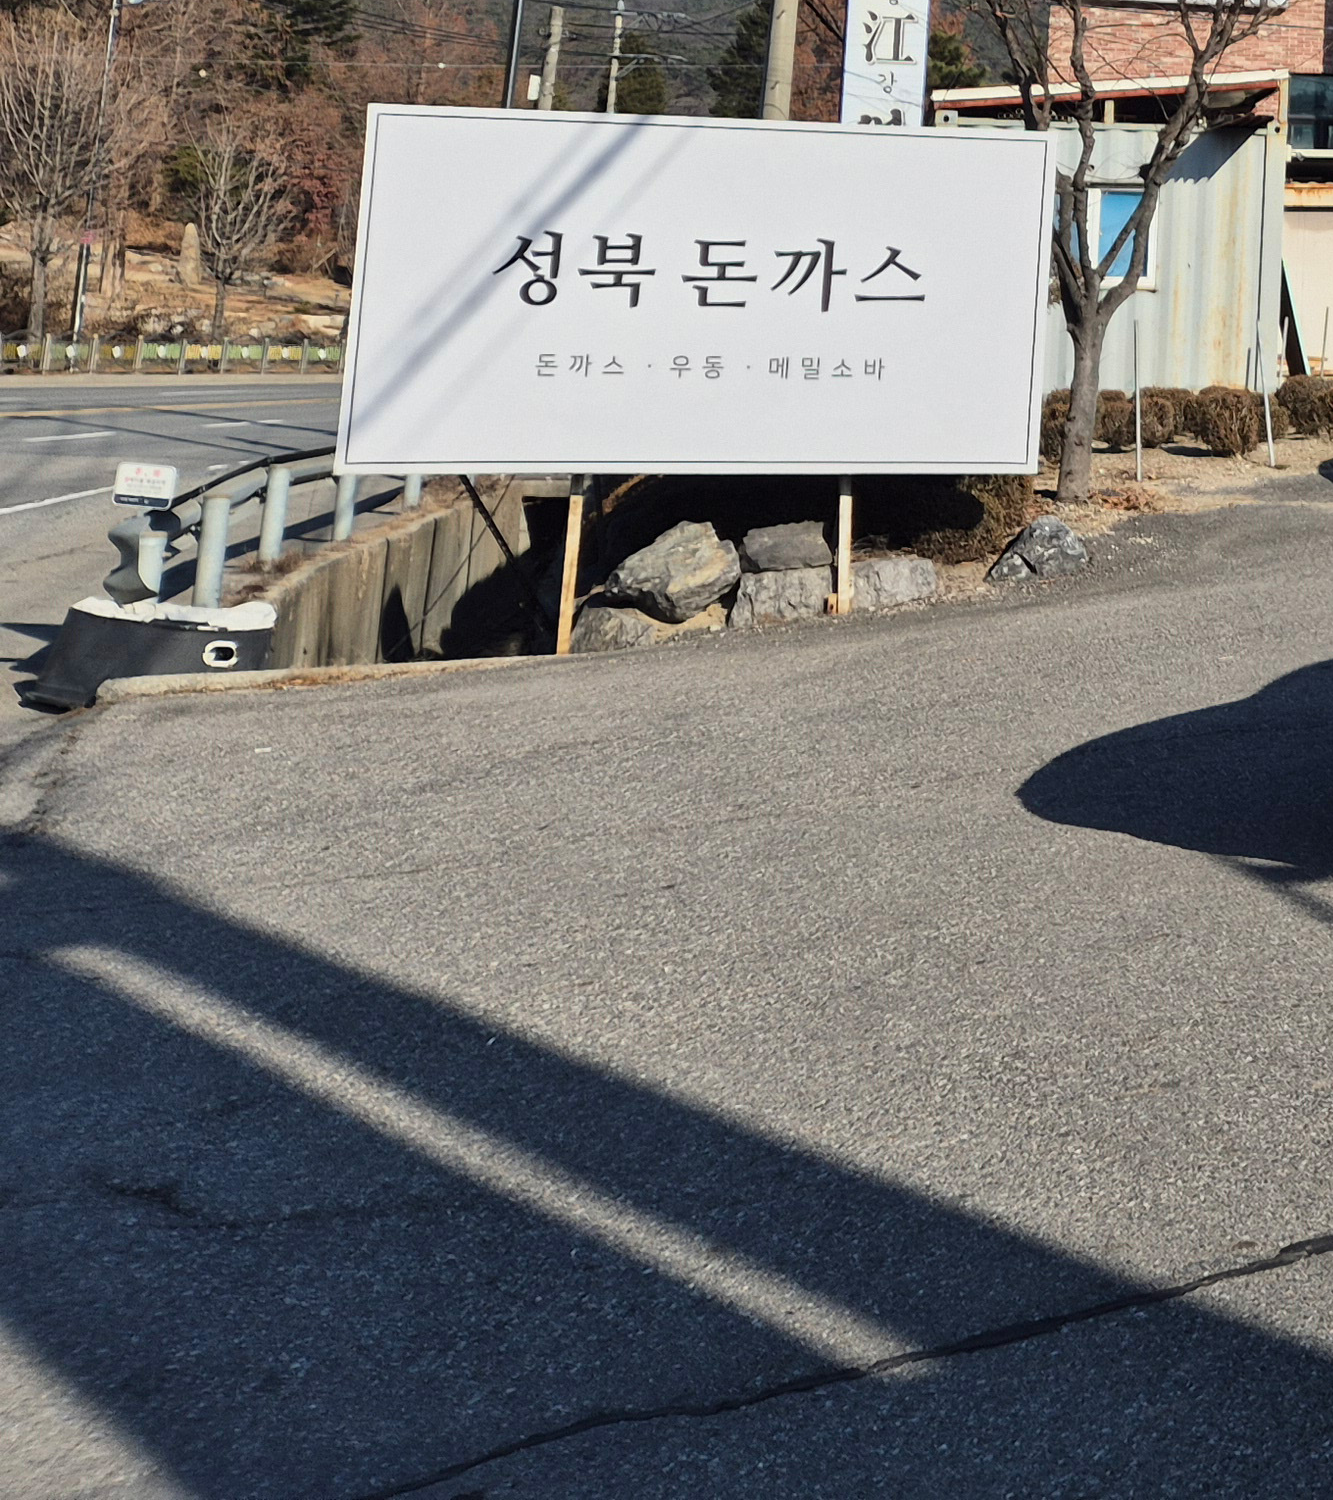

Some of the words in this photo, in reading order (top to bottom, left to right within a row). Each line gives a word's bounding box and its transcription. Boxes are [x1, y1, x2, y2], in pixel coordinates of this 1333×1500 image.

[492, 230, 656, 308] 성북
[681, 238, 926, 313] 돈까스
[535, 353, 625, 378] 돈까스
[669, 355, 725, 380] 우동
[768, 356, 886, 381] 메밀소바
